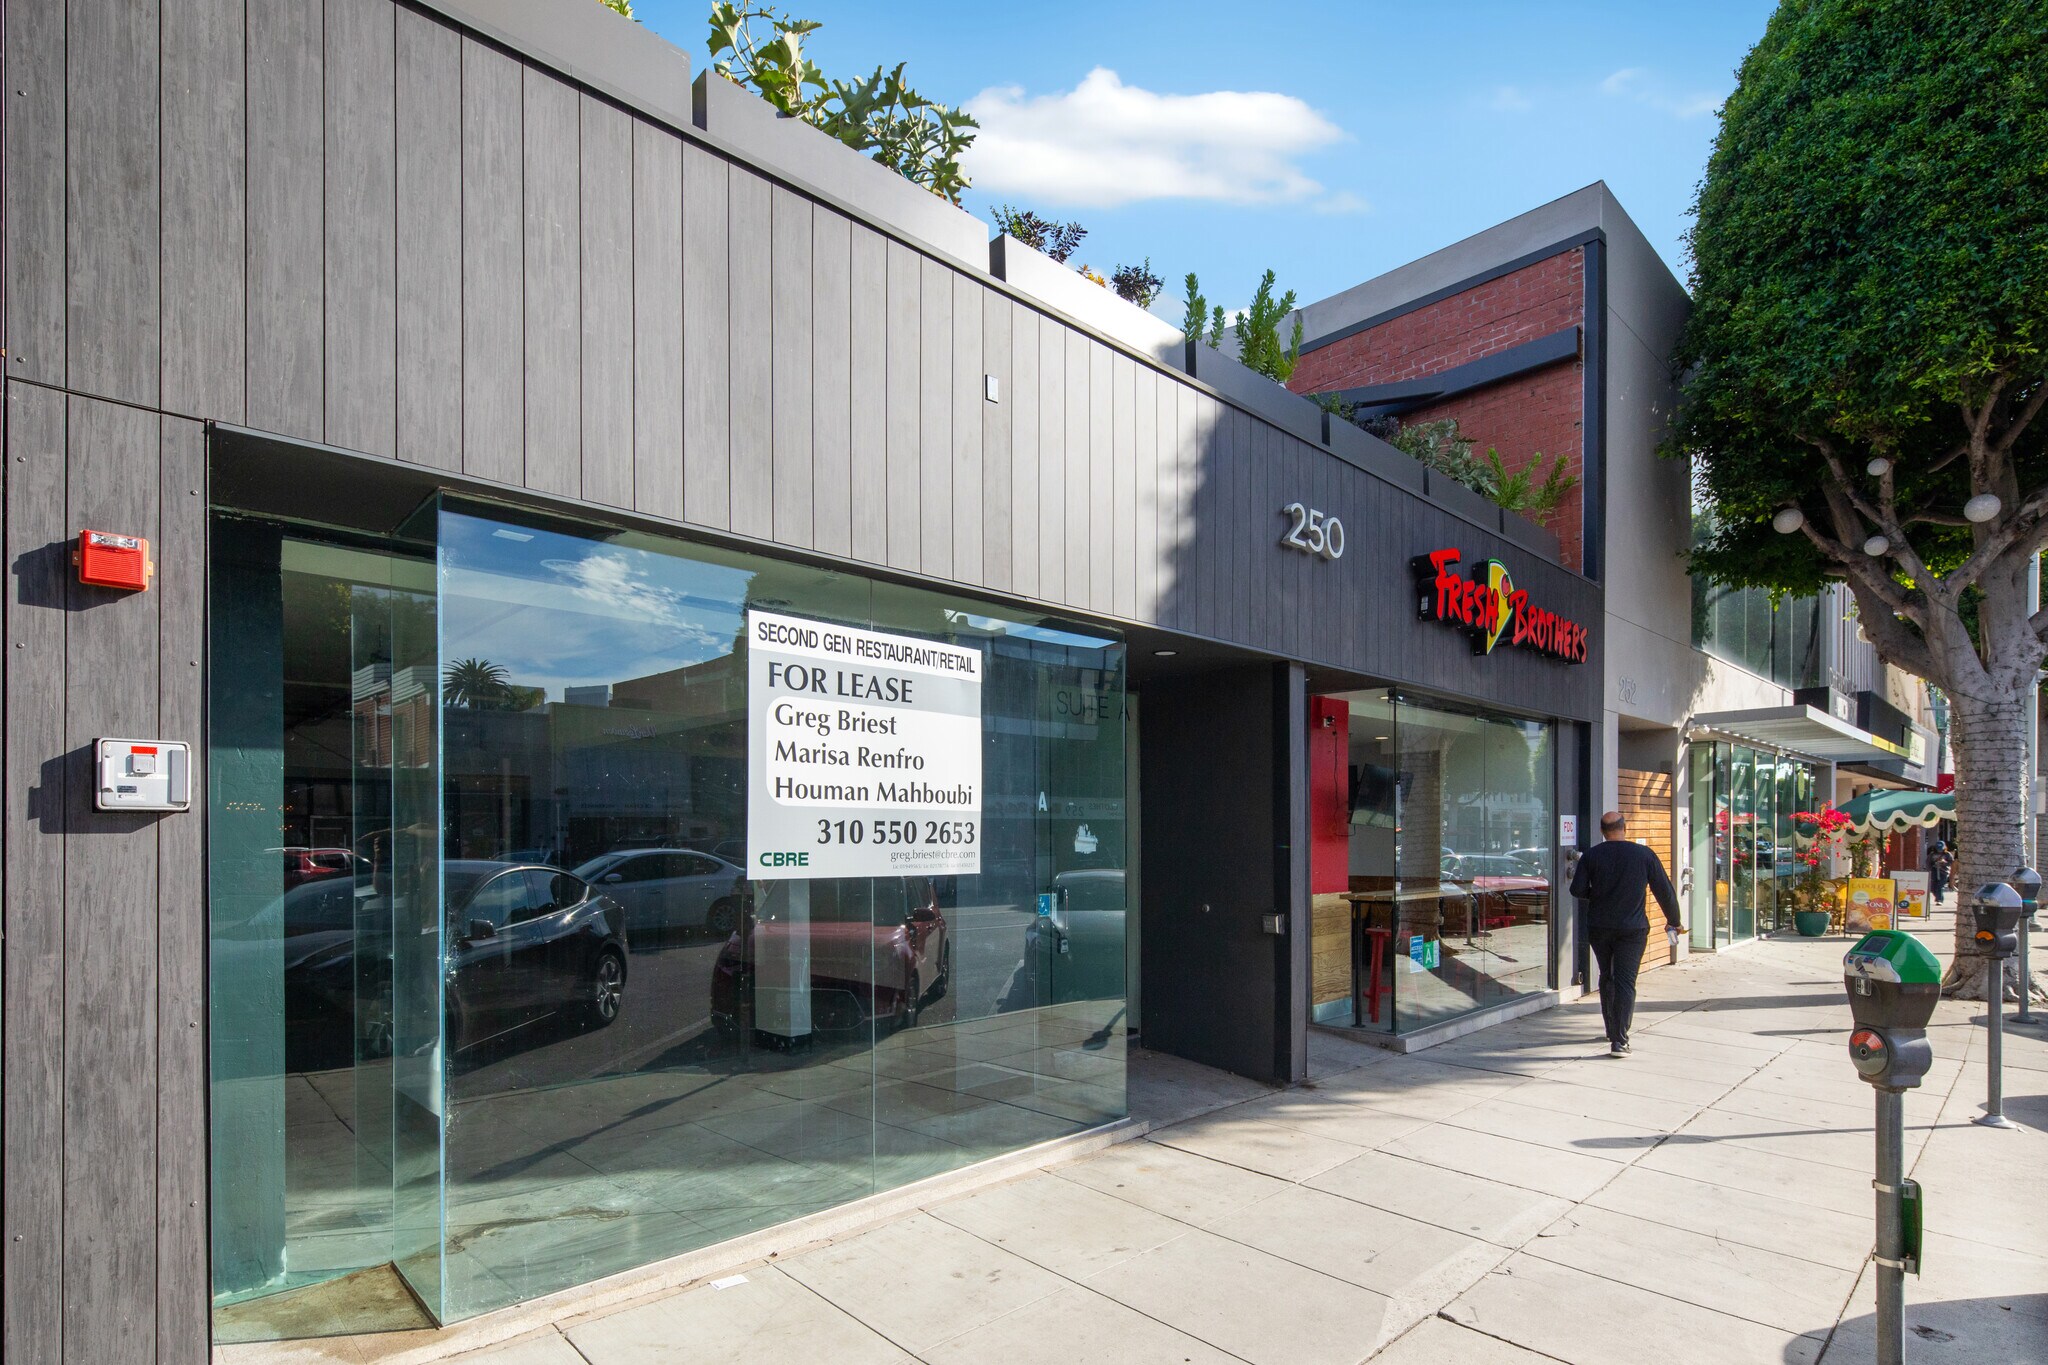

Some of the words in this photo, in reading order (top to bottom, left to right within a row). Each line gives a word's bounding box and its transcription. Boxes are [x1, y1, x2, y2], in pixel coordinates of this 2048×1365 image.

[1282, 502, 1345, 560] 250
[1429, 547, 1499, 635] FRESH
[1508, 588, 1589, 664] BROTHERS
[757, 621, 819, 649] SECOND
[823, 633, 852, 655] GEN
[856, 638, 976, 675] RESTAURANT/RETAIL
[768, 661, 828, 694] FOR
[837, 670, 913, 704] LEASE
[774, 703, 831, 736] Greg
[838, 709, 897, 736] Briest
[774, 740, 850, 766] Marisa
[857, 746, 925, 771] Renfro
[774, 776, 869, 802] Houman
[876, 781, 973, 805] Mahboubi
[1038, 791, 1048, 812] A
[817, 819, 864, 845] 310
[872, 819, 917, 845] 550
[924, 820, 976, 845] 2653
[1563, 821, 1573, 833] FDC
[759, 851, 809, 867] CBRE
[890, 849, 976, 863] greg.briest@cbre.com
[1425, 948, 1432, 964] A
